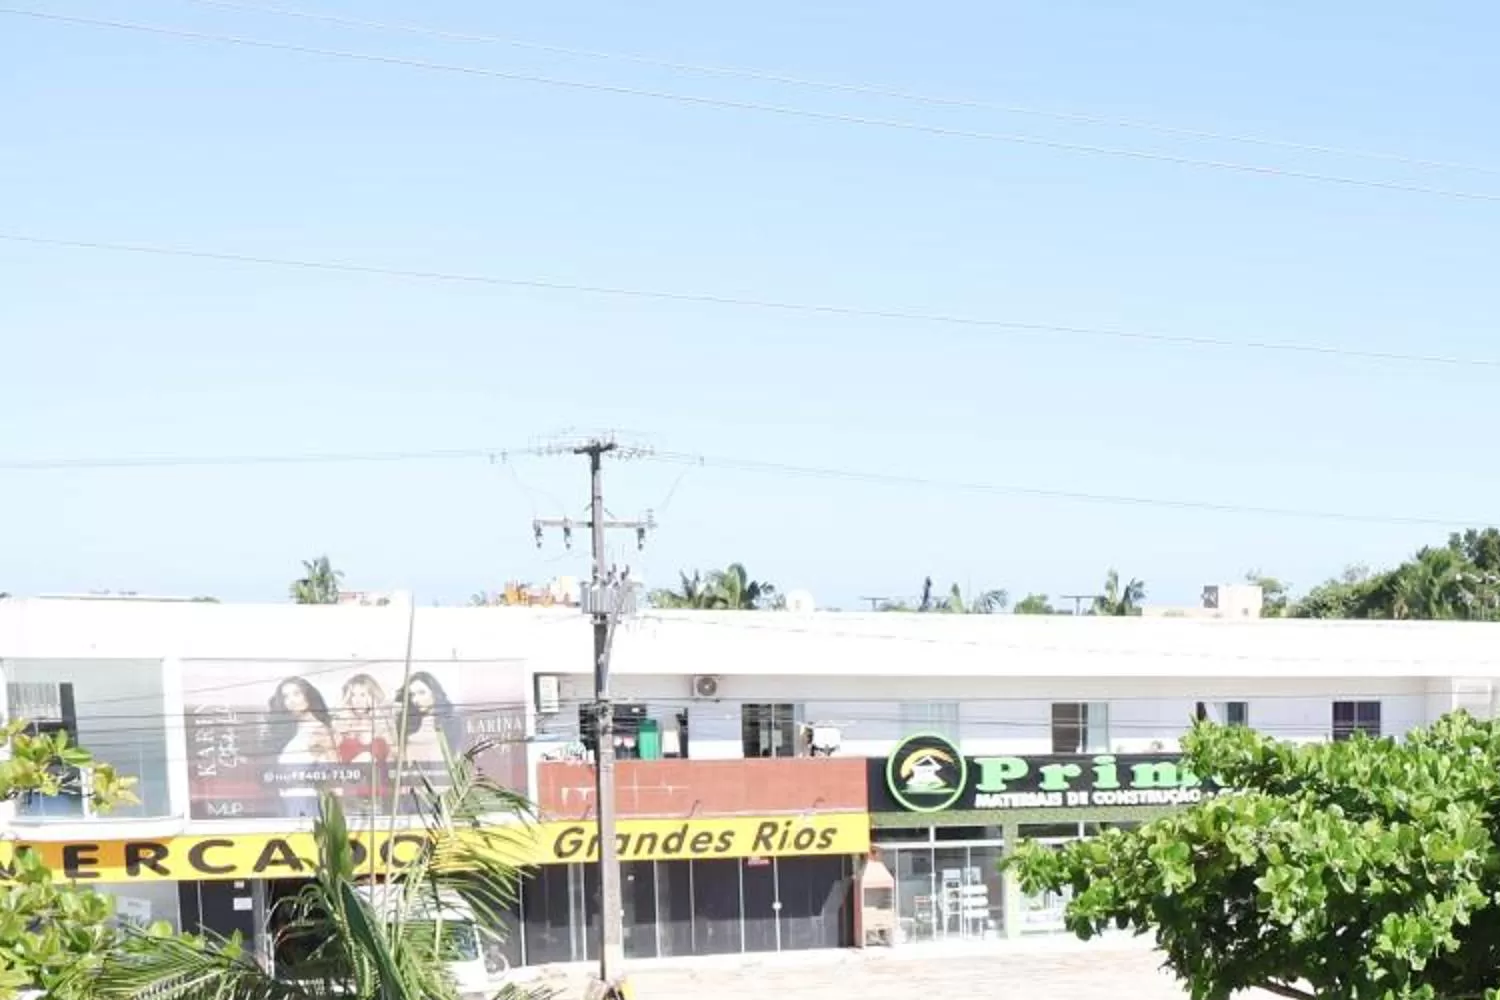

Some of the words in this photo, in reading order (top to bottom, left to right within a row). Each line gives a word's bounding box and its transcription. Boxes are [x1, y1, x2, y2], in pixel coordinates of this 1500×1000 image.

[974, 755, 1232, 792] Prim
[1067, 790, 1089, 806] DE
[553, 823, 735, 859] Grandes
[752, 820, 838, 852] Rios
